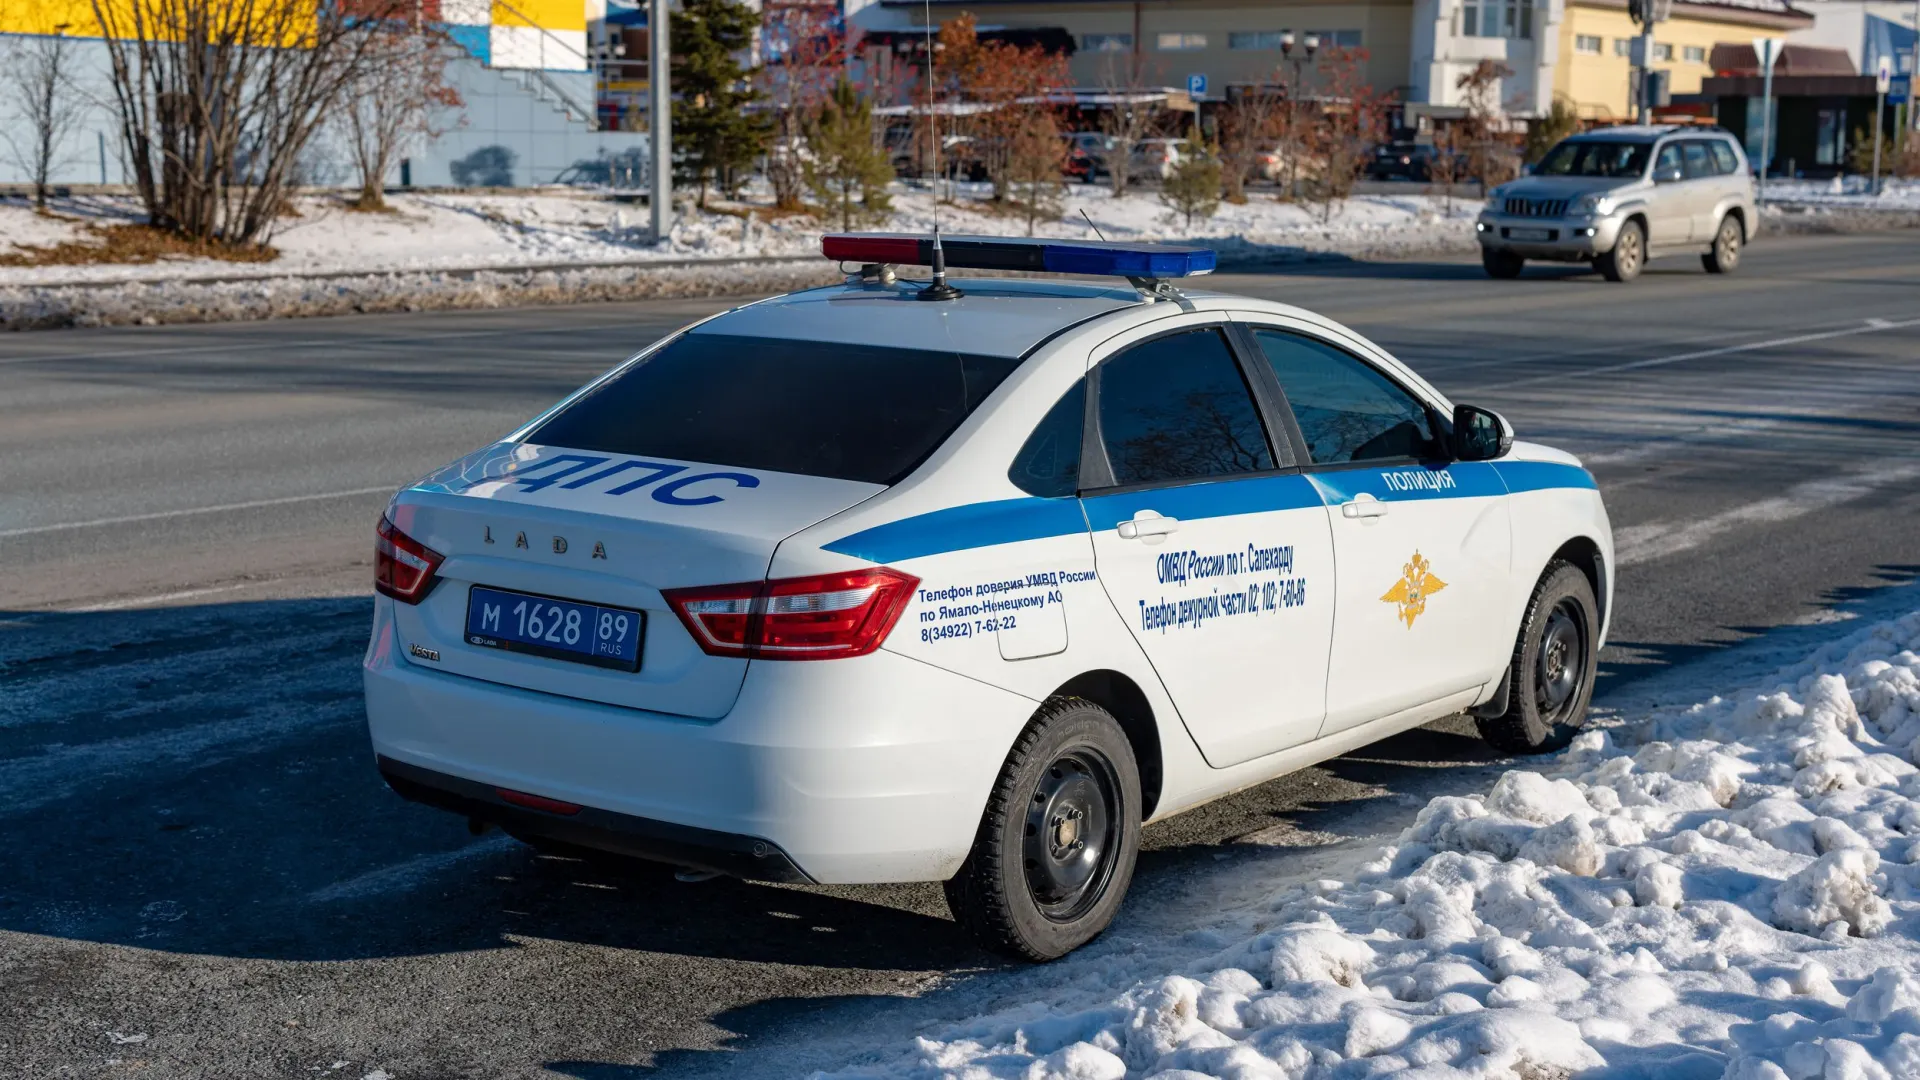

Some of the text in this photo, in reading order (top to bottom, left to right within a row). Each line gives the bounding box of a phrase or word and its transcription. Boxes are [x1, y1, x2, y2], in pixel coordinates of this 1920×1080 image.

[460, 454, 760, 506] ДПС
[1381, 470, 1456, 493] ПОЛИЦИЯ
[484, 525, 607, 560] LADA
[1156, 542, 1294, 587] ОМВД России по г. Салехарду
[918, 570, 1096, 602] Телефон доверия УМВД России
[513, 600, 582, 645] 1628
[598, 612, 629, 643] 89
[920, 590, 1063, 622] по Ямало-Ненецкому АО
[1139, 577, 1306, 635] Телефон дежурной части 02; 102; 7-60-86
[921, 615, 1017, 644] 8(34922) 7-62-22
[600, 642, 622, 655] RUS
